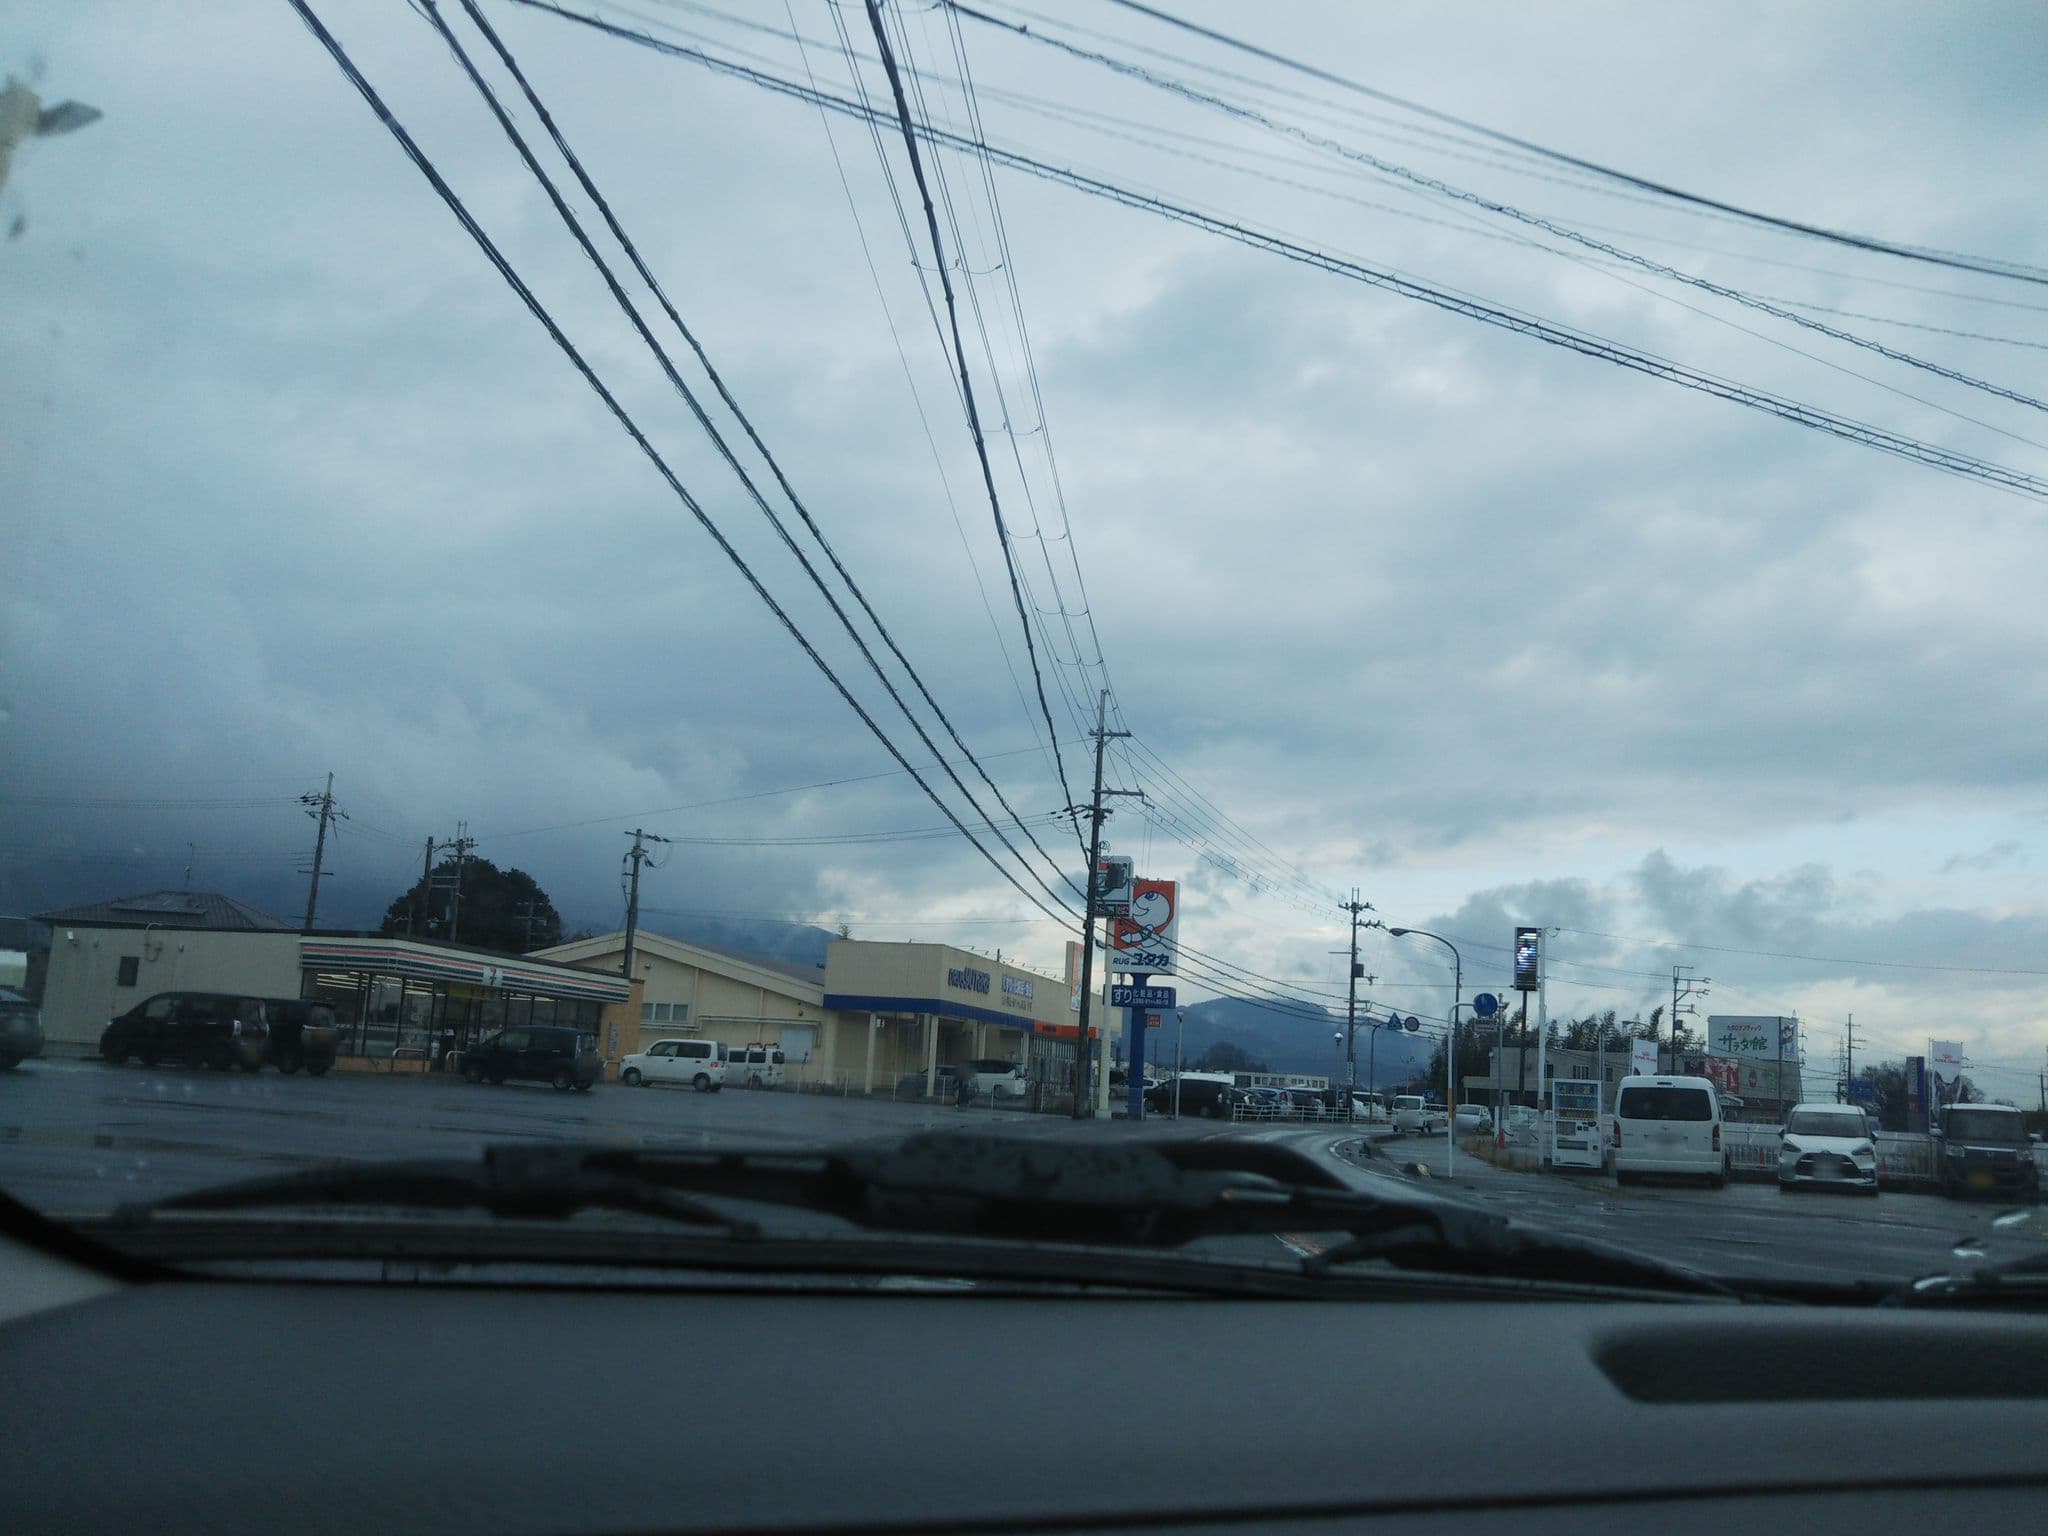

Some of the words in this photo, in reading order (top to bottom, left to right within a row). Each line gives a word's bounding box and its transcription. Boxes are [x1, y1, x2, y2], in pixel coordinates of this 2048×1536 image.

[1131, 952, 1170, 967] ユタカ
[1113, 988, 1132, 1004] すり
